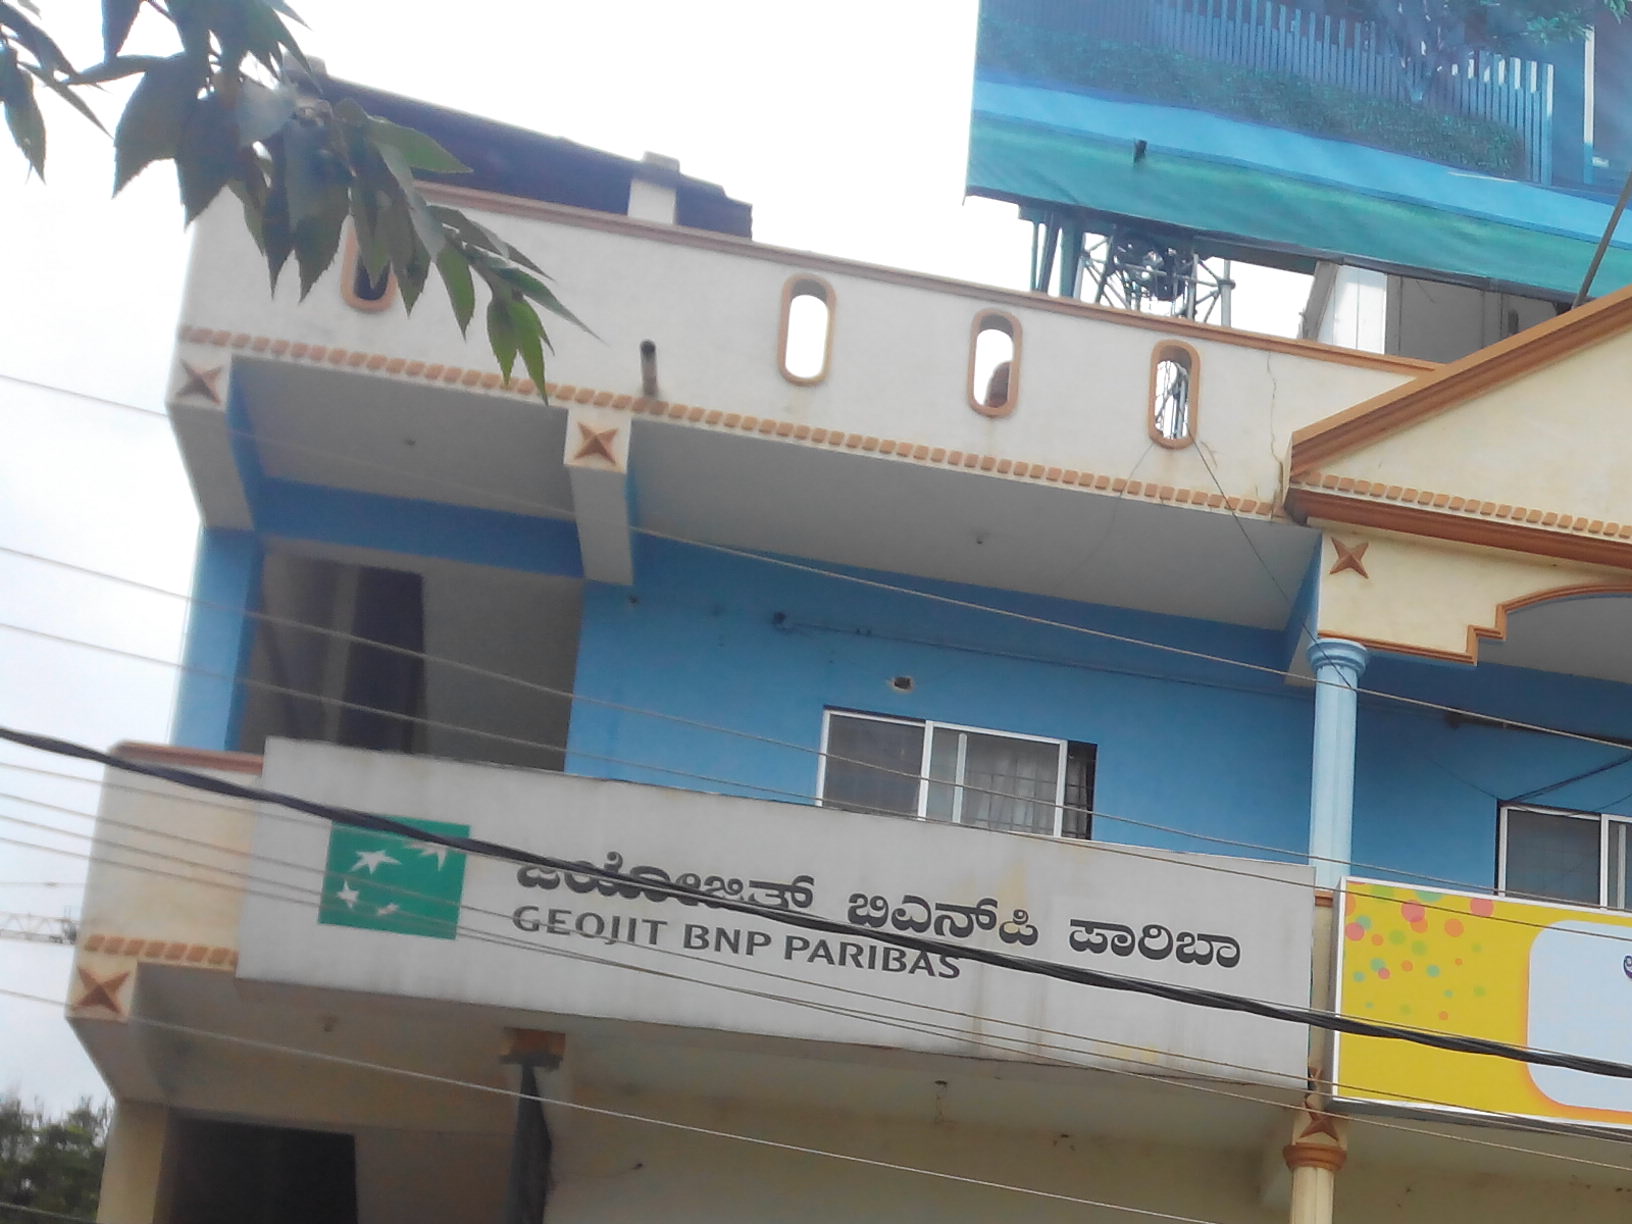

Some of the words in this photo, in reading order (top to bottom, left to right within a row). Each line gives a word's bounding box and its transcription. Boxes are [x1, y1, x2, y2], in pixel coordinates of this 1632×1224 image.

[512, 904, 669, 946] GEOJIT
[682, 922, 772, 957] BNP
[783, 934, 961, 979] PARIBAS
[1069, 918, 1241, 968] ಪಾರಿಬಾ
